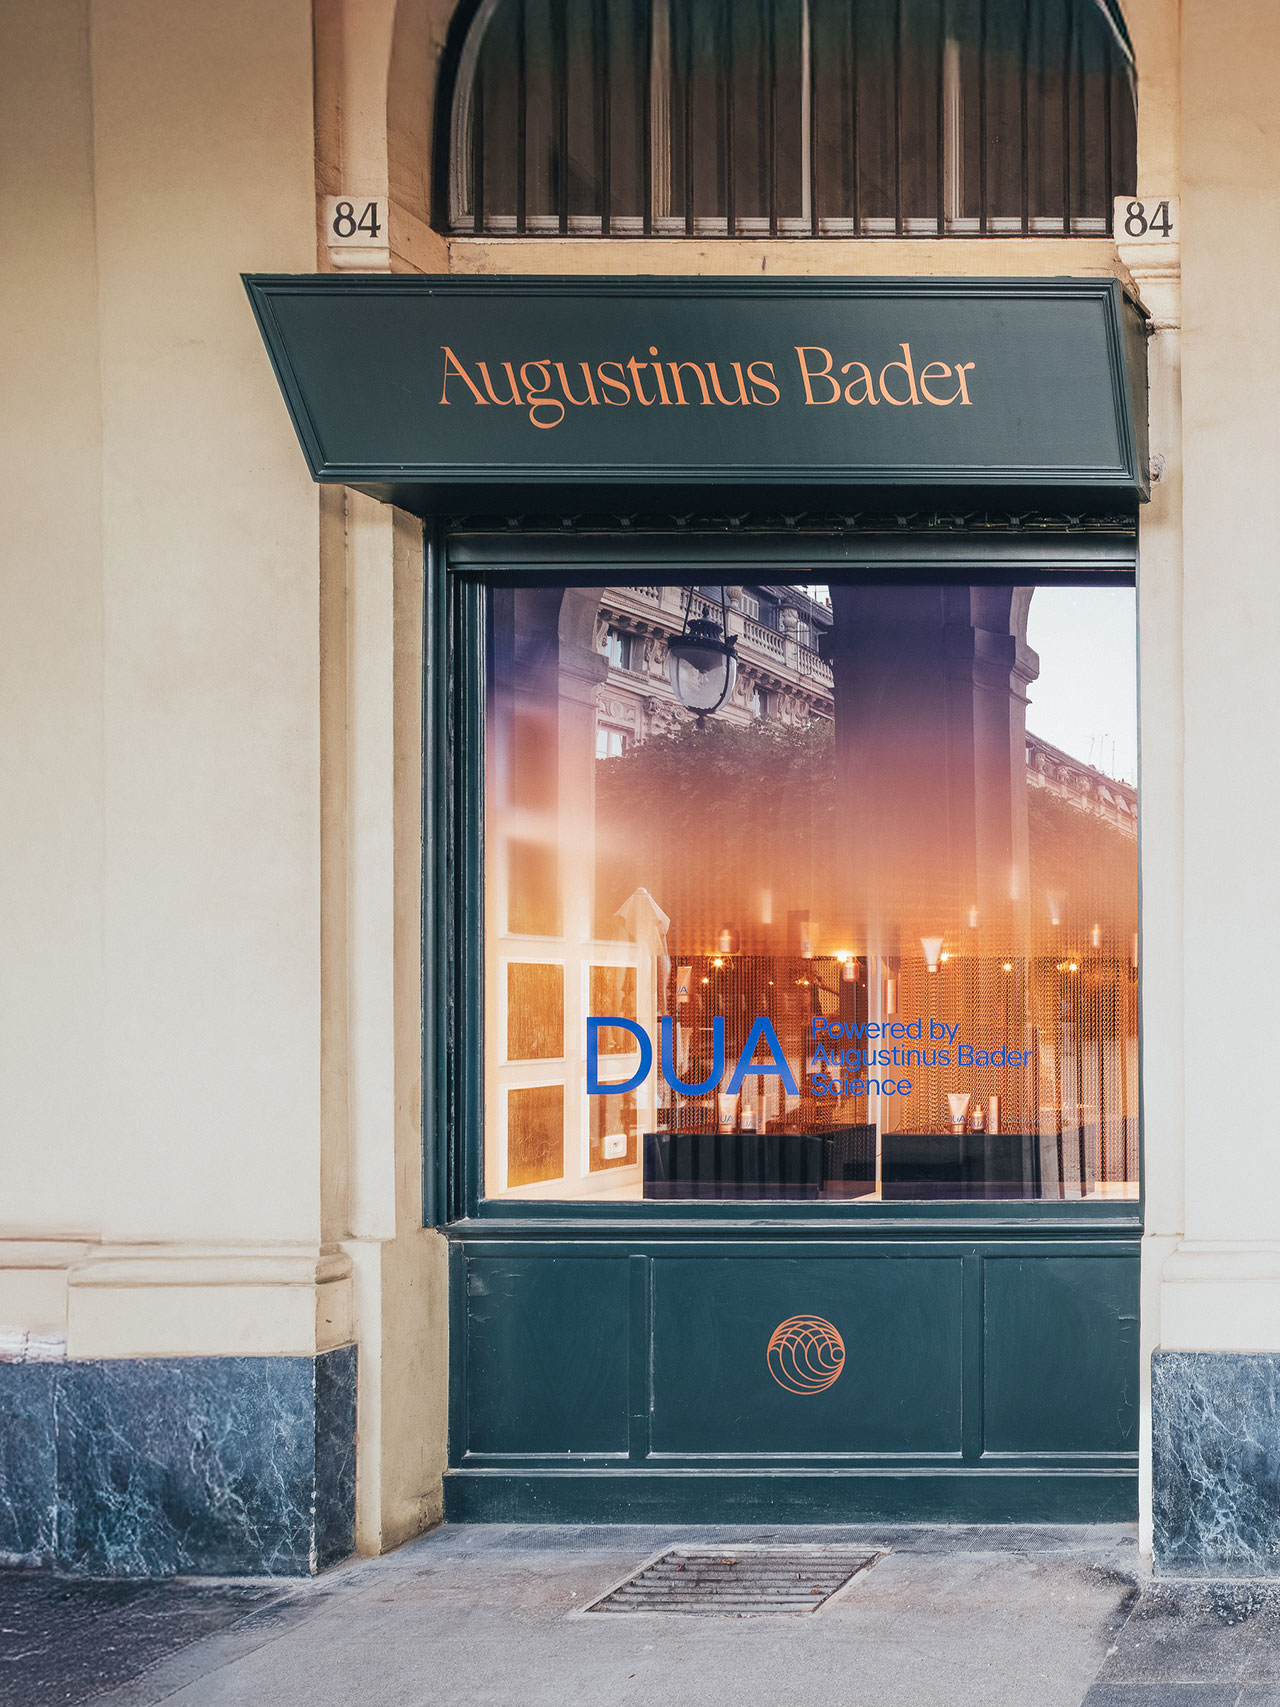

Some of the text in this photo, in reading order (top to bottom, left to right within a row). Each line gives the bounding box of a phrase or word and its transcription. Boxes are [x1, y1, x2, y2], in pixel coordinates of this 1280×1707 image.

[332, 201, 382, 238] 84
[1124, 201, 1173, 238] 84
[439, 342, 976, 430] Augustinus Bader
[811, 1016, 960, 1046] Powered by
[586, 1016, 799, 1096] DUA
[810, 1044, 1034, 1072] Augustinus Bader
[811, 1072, 913, 1097] Science
